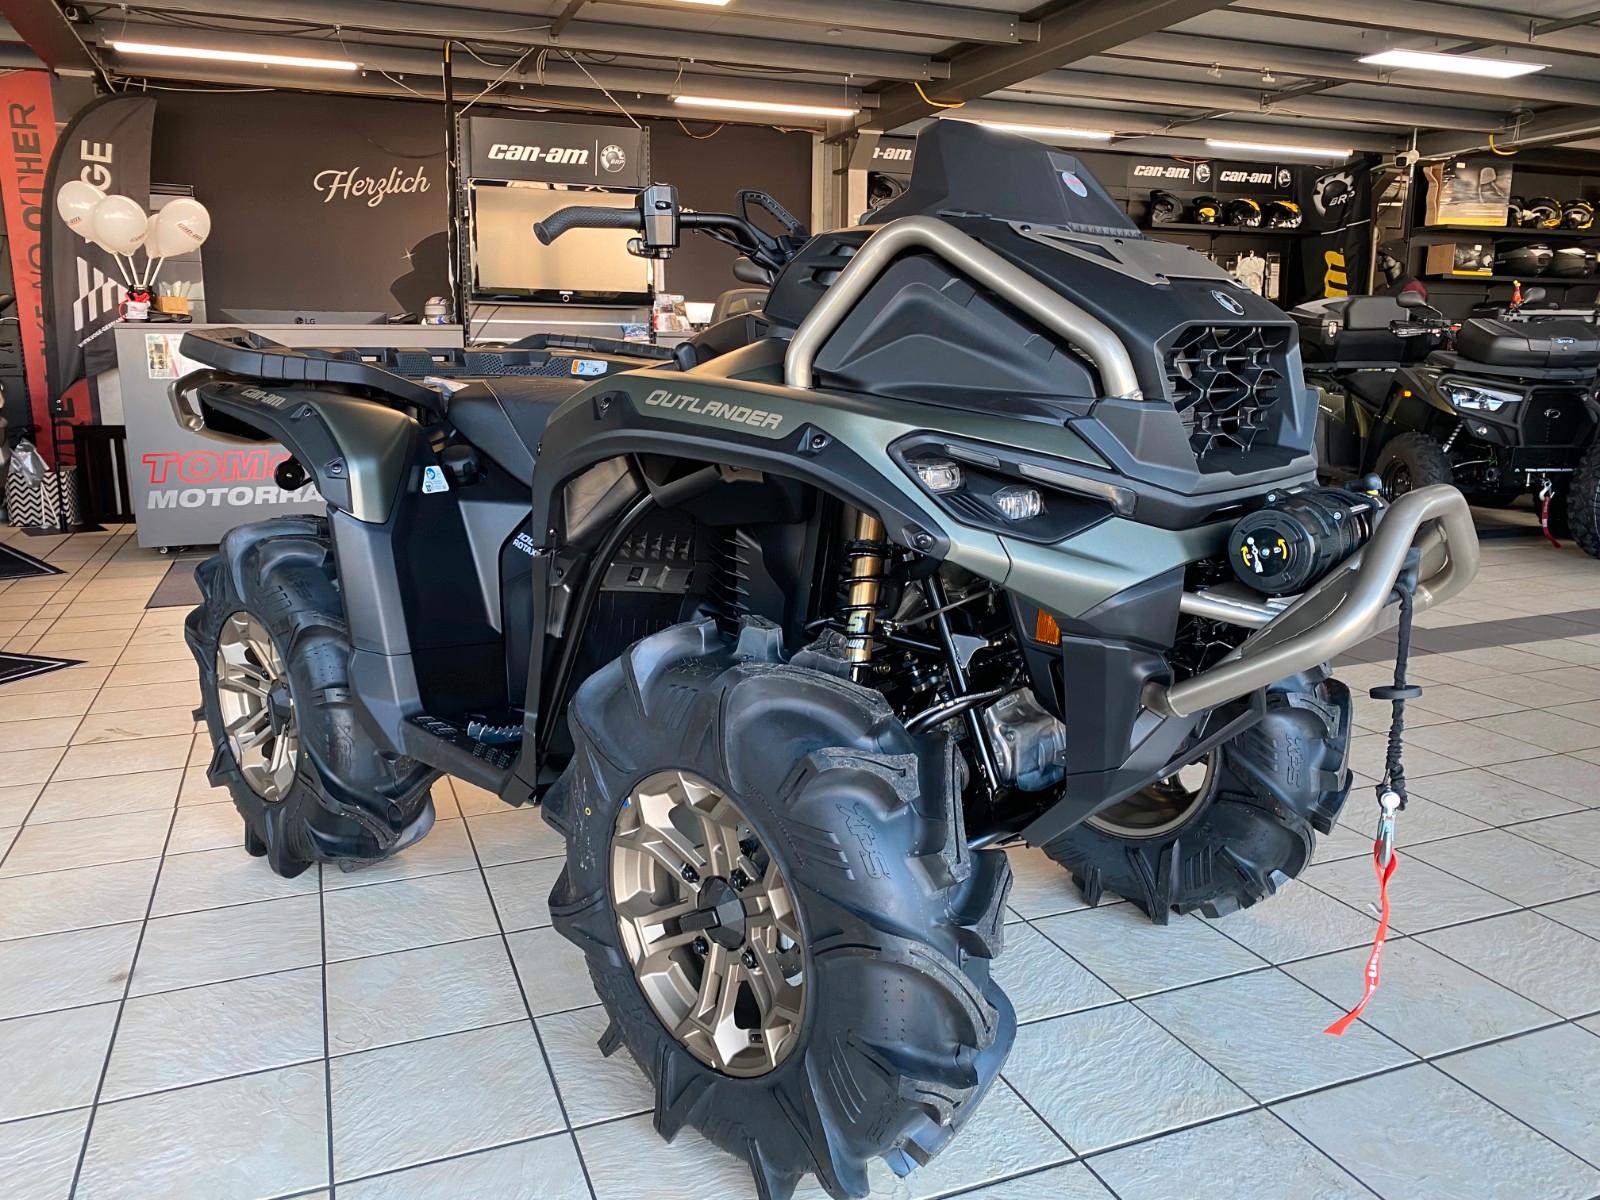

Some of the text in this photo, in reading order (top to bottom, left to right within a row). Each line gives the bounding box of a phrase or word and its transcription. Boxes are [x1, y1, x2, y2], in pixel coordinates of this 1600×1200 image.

[9, 103, 44, 232] OTHER
[487, 143, 589, 165] can-am
[313, 166, 431, 207] Herzlich
[1133, 165, 1190, 179] can-am
[1220, 170, 1272, 184] can-am
[645, 389, 783, 430] OUTLANDER
